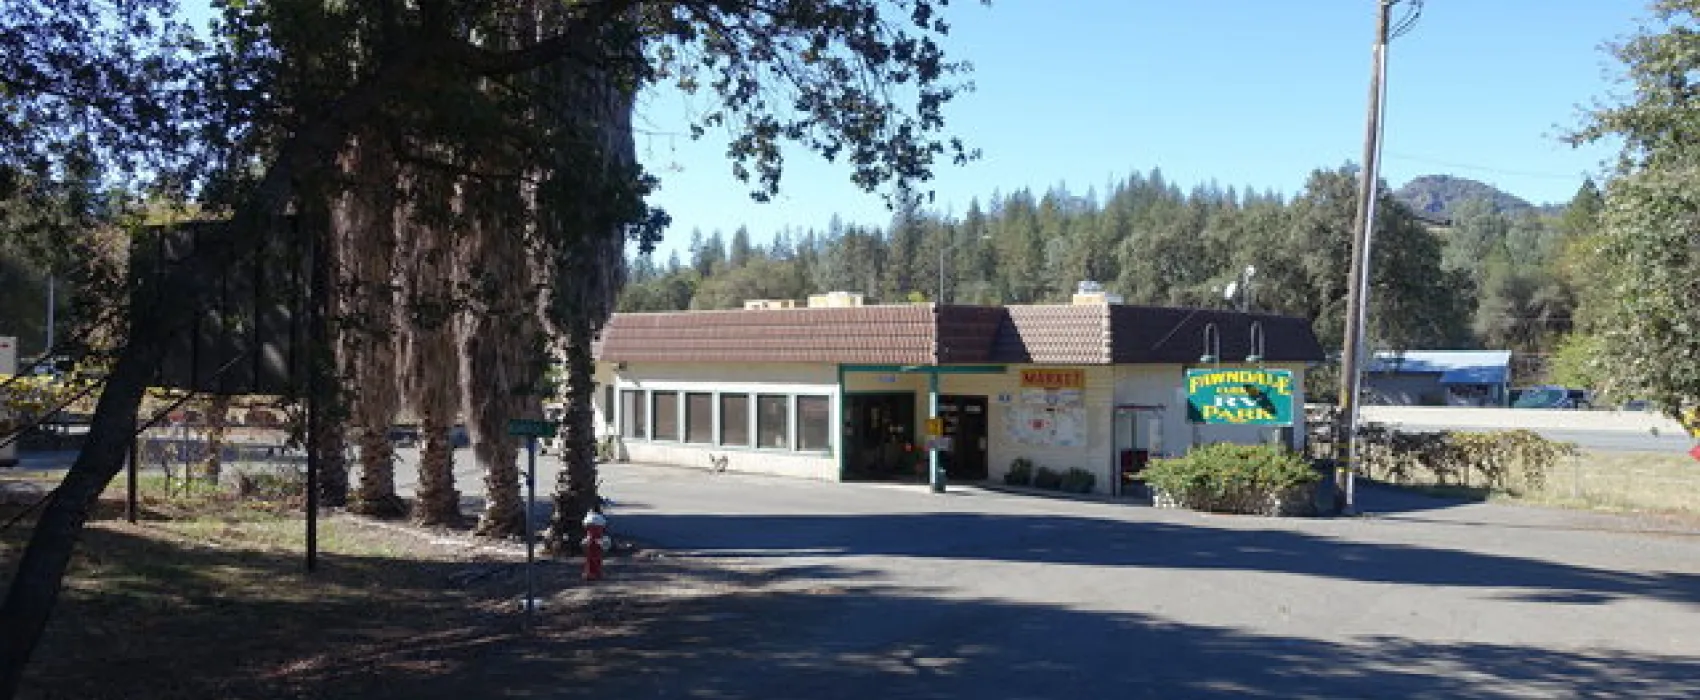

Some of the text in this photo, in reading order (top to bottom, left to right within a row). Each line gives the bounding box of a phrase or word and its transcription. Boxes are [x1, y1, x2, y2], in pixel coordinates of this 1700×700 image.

[1023, 372, 1081, 386] MARKET
[1189, 370, 1292, 395] FAWNDALE
[1202, 405, 1276, 421] PARK
